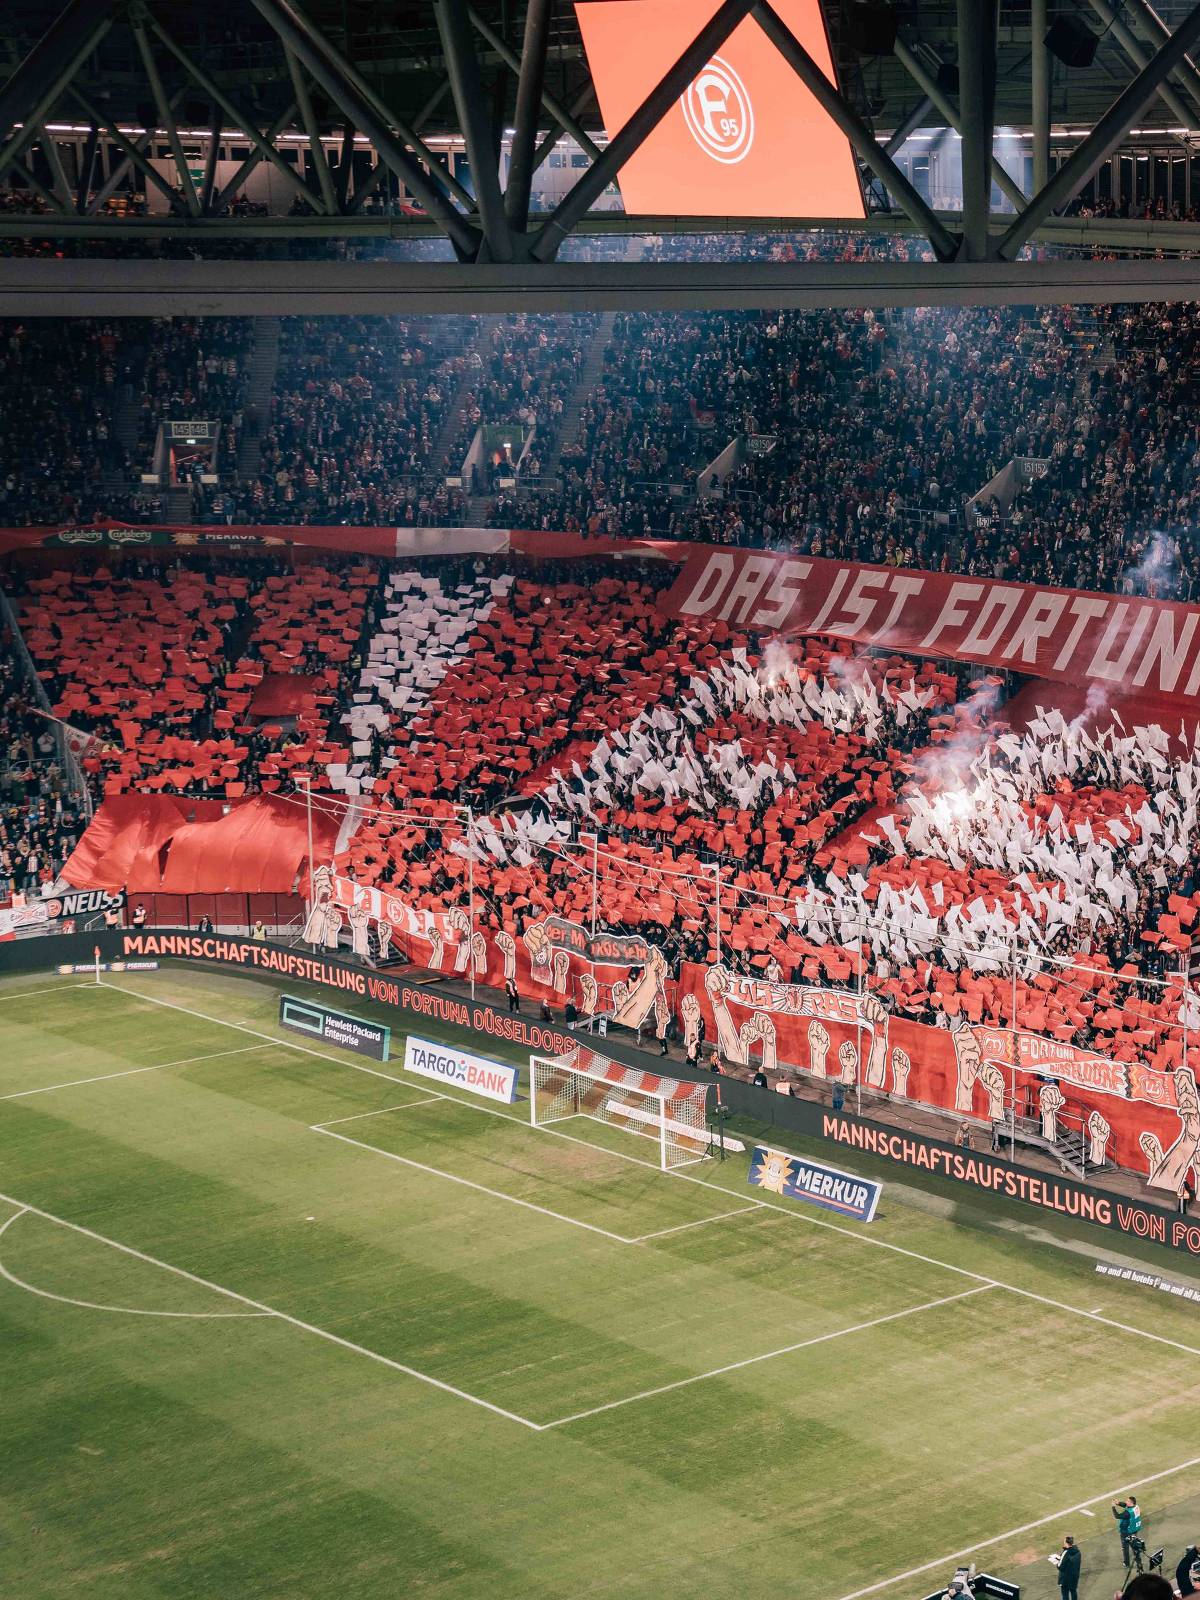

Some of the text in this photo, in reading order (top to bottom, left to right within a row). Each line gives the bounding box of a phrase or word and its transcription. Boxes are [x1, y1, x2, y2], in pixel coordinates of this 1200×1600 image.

[58, 529, 103, 543] Carlsberg
[108, 528, 152, 543] Carlsberg
[679, 552, 813, 629] DAS
[806, 568, 926, 641] IST
[123, 935, 366, 995] MANNSCHAFTSAUFSTELLUNG
[368, 977, 399, 1005] VON
[402, 988, 470, 1027] FORTUNA
[324, 1026, 359, 1046] Enterprise
[325, 1015, 381, 1042] Hewlett Packard
[1020, 1037, 1075, 1060] FORTUNA
[795, 1167, 869, 1209] MERKUR
[823, 1115, 1111, 1225] MANNSCHAFTSAUFSTELLUNG
[1117, 1203, 1165, 1242] VON
[1095, 1263, 1107, 1273] me
[1107, 1266, 1121, 1277] and
[1121, 1268, 1131, 1280] all
[1131, 1270, 1153, 1286] hotels
[1160, 1281, 1170, 1291] me
[1170, 1284, 1184, 1296] and
[1184, 1288, 1192, 1299] all
